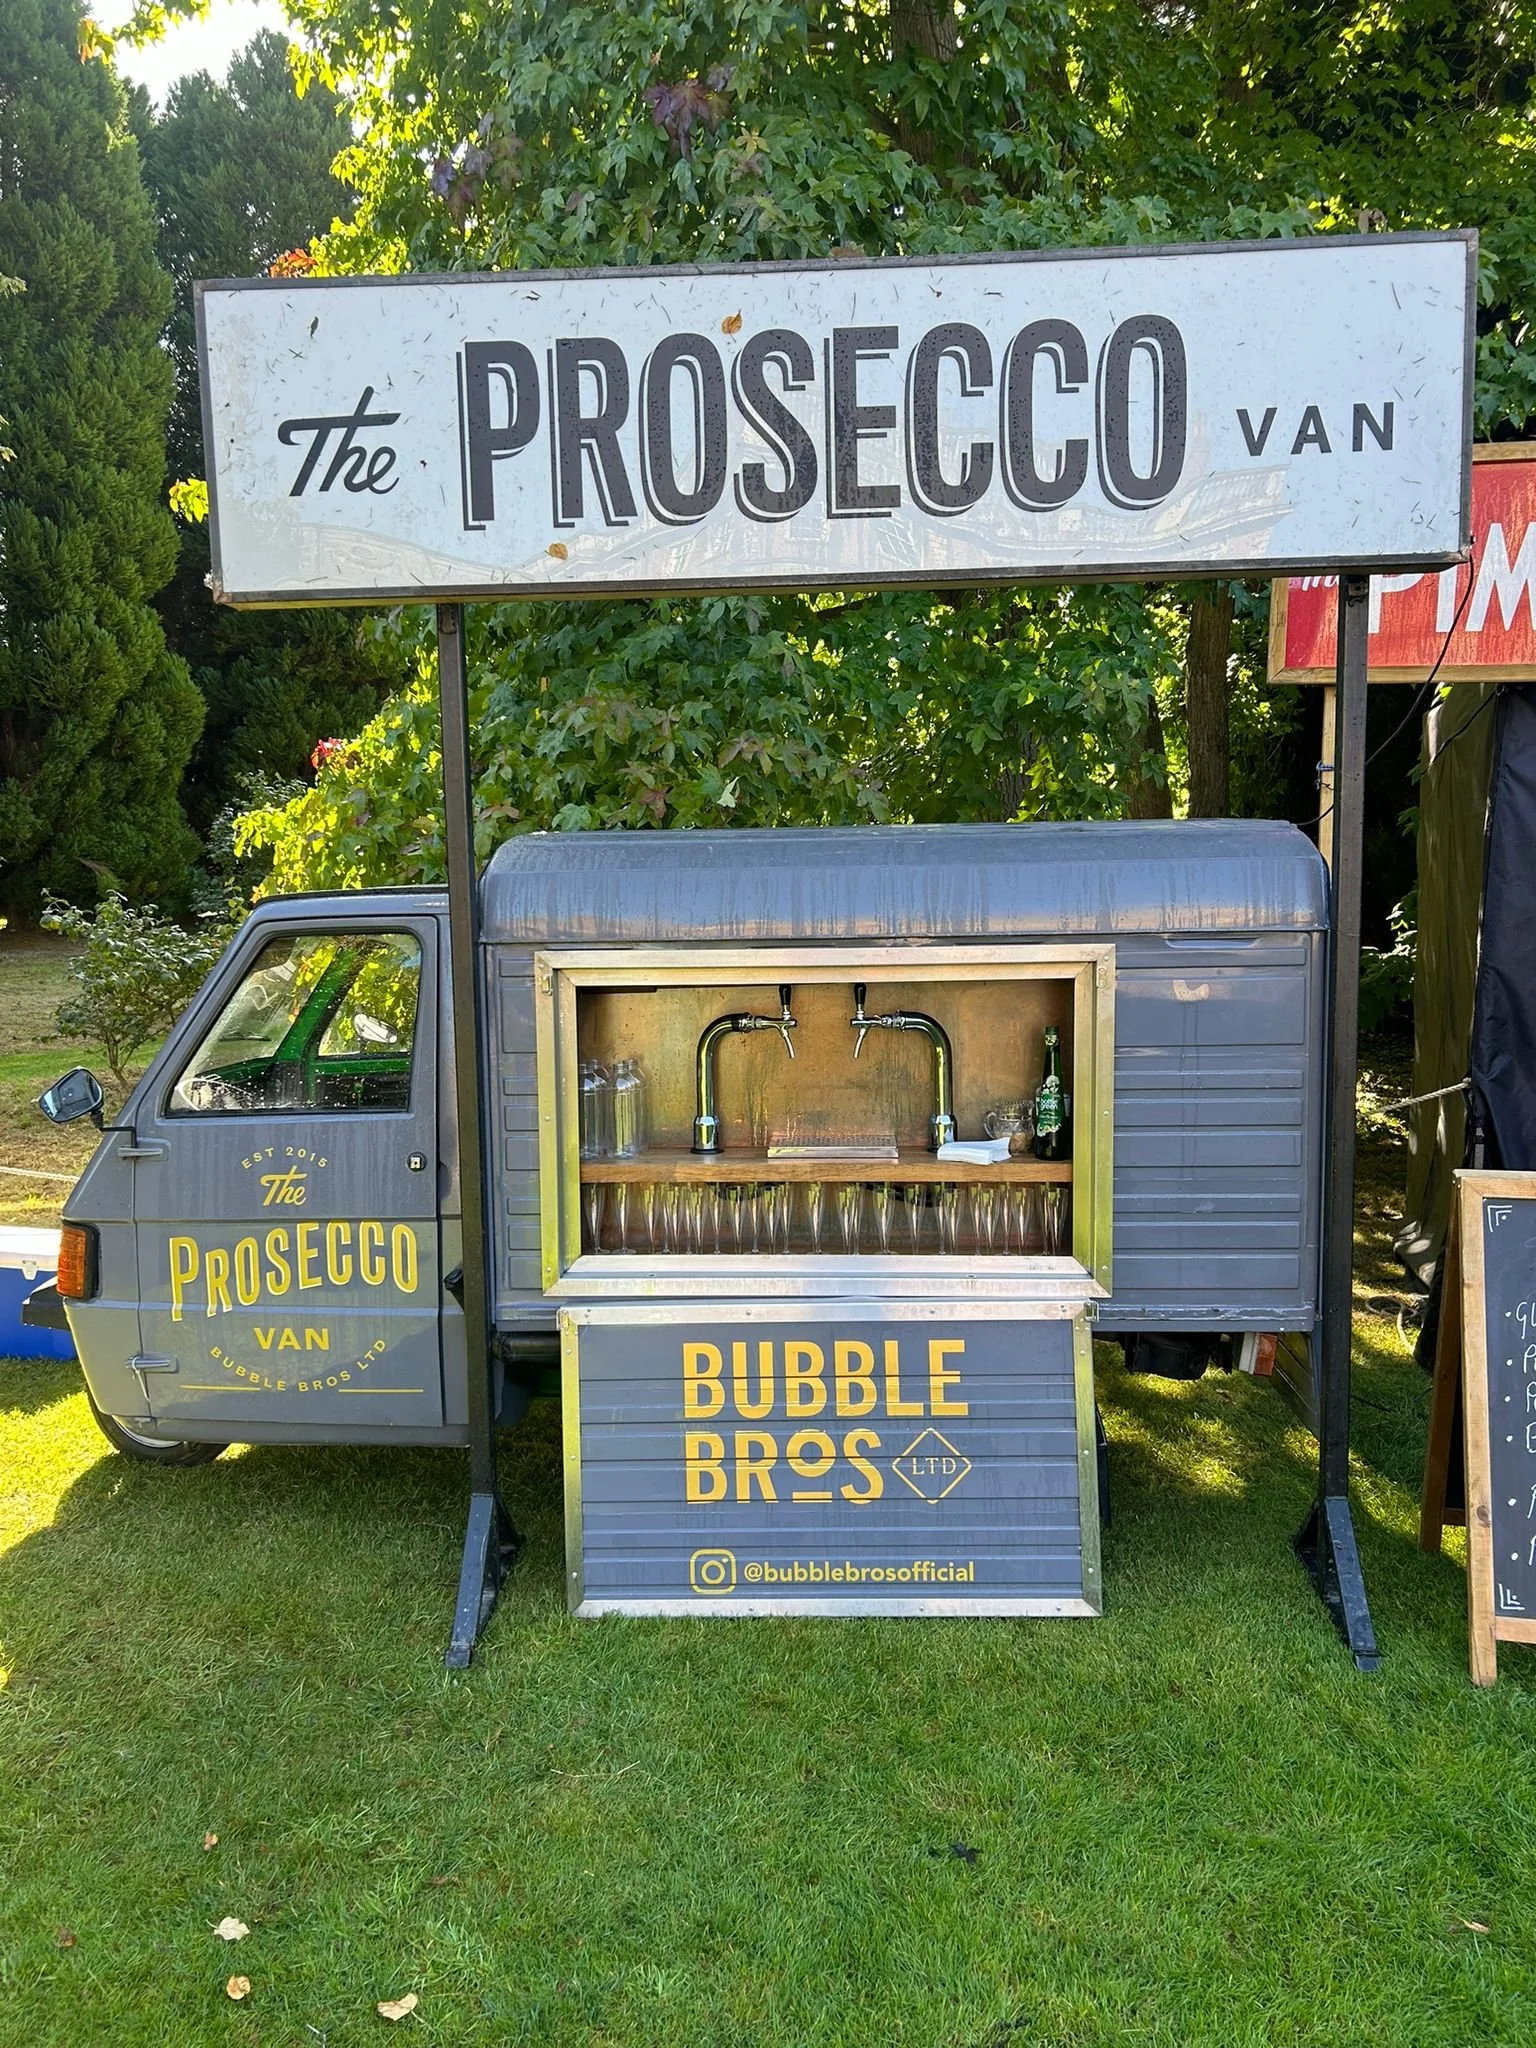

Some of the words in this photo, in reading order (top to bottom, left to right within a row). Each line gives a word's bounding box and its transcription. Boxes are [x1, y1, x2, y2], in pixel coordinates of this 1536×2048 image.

[277, 385, 401, 497] The
[455, 314, 1188, 531] PROSECCO
[1236, 401, 1395, 457] VAN
[242, 1147, 275, 1169] EST
[286, 1146, 328, 1168] 2015
[260, 1165, 308, 1206] The
[169, 1220, 418, 1322] PROSECCO
[210, 1346, 287, 1392] BUBBLE
[298, 1370, 352, 1392] BROS
[356, 1338, 387, 1371] LTD
[253, 1327, 330, 1351] VAN
[682, 1339, 969, 1419] BUBBLE
[685, 1428, 885, 1505] BROS
[911, 1457, 957, 1476] LTD
[743, 1560, 976, 1583] @bubblebrosofficial
